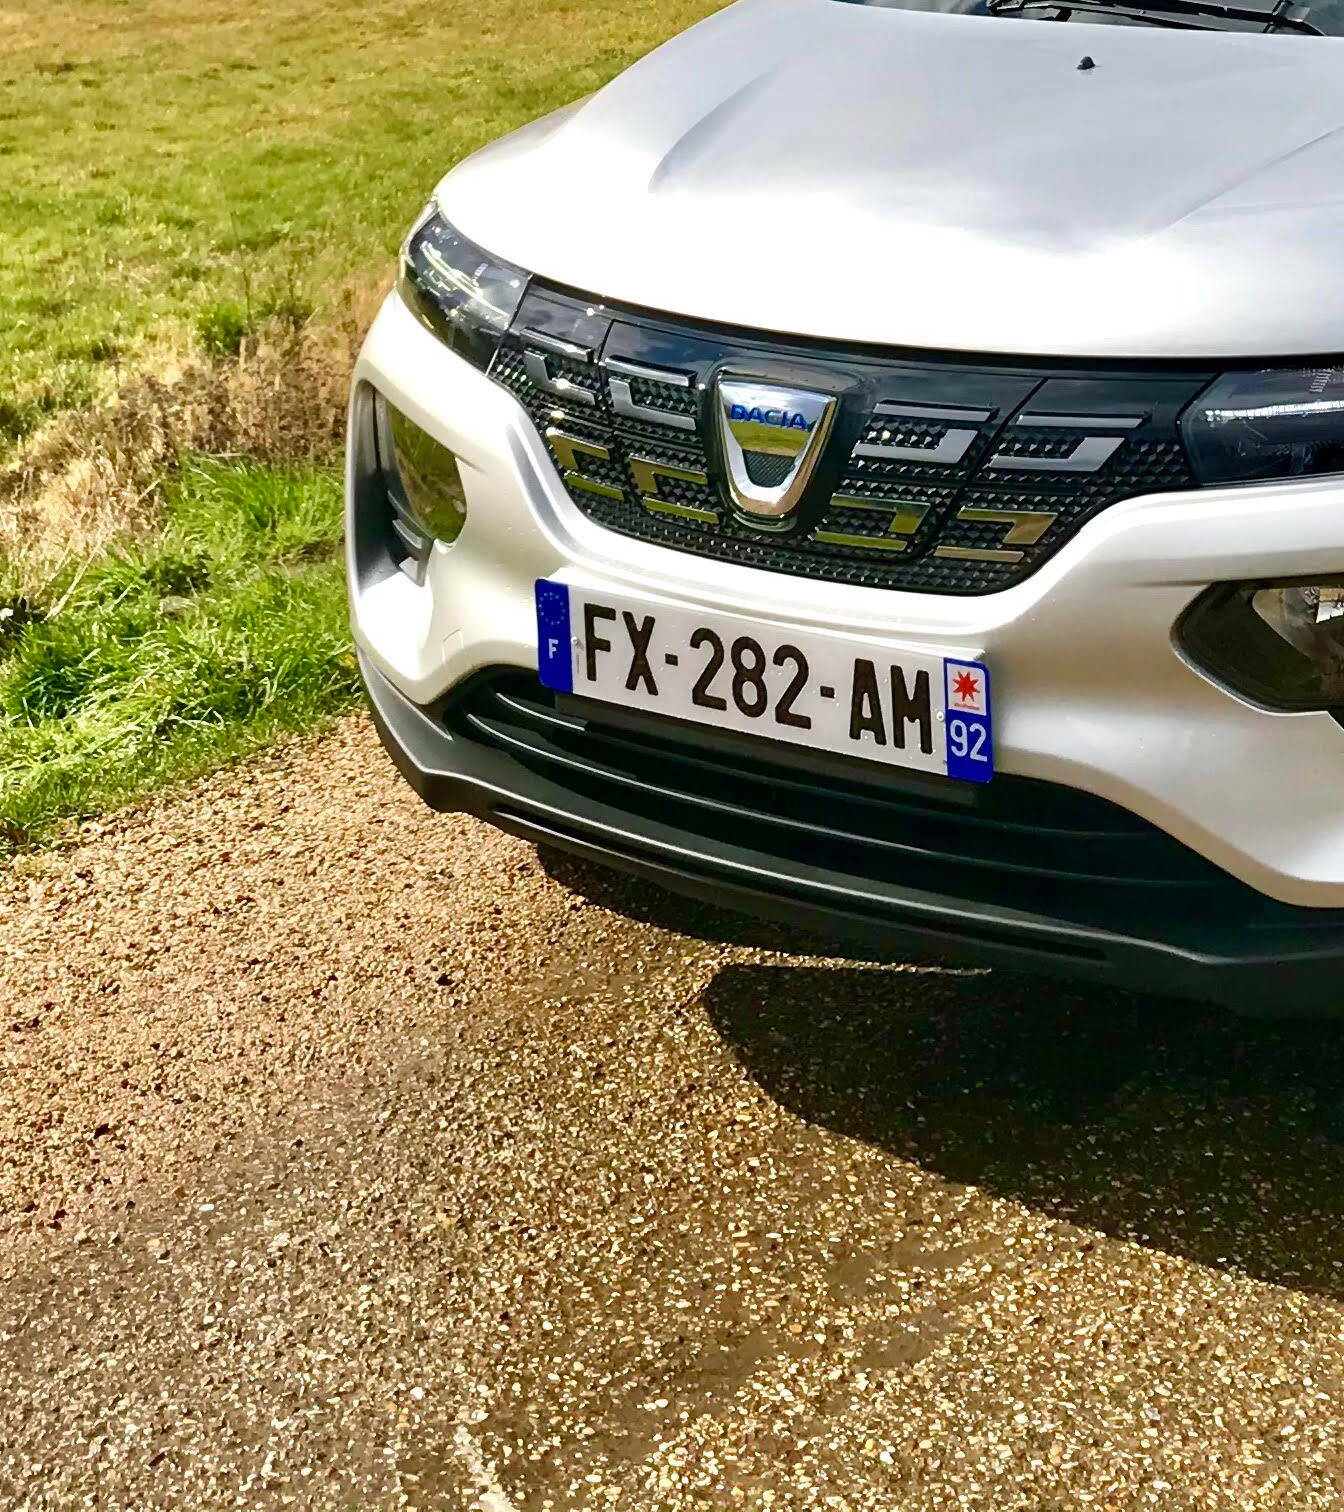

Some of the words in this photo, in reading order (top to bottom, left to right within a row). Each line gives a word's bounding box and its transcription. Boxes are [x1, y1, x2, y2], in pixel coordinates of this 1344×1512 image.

[730, 403, 807, 430] DACIA
[547, 638, 559, 659] F
[583, 602, 934, 755] FX-282-AM
[949, 719, 988, 762] 92
